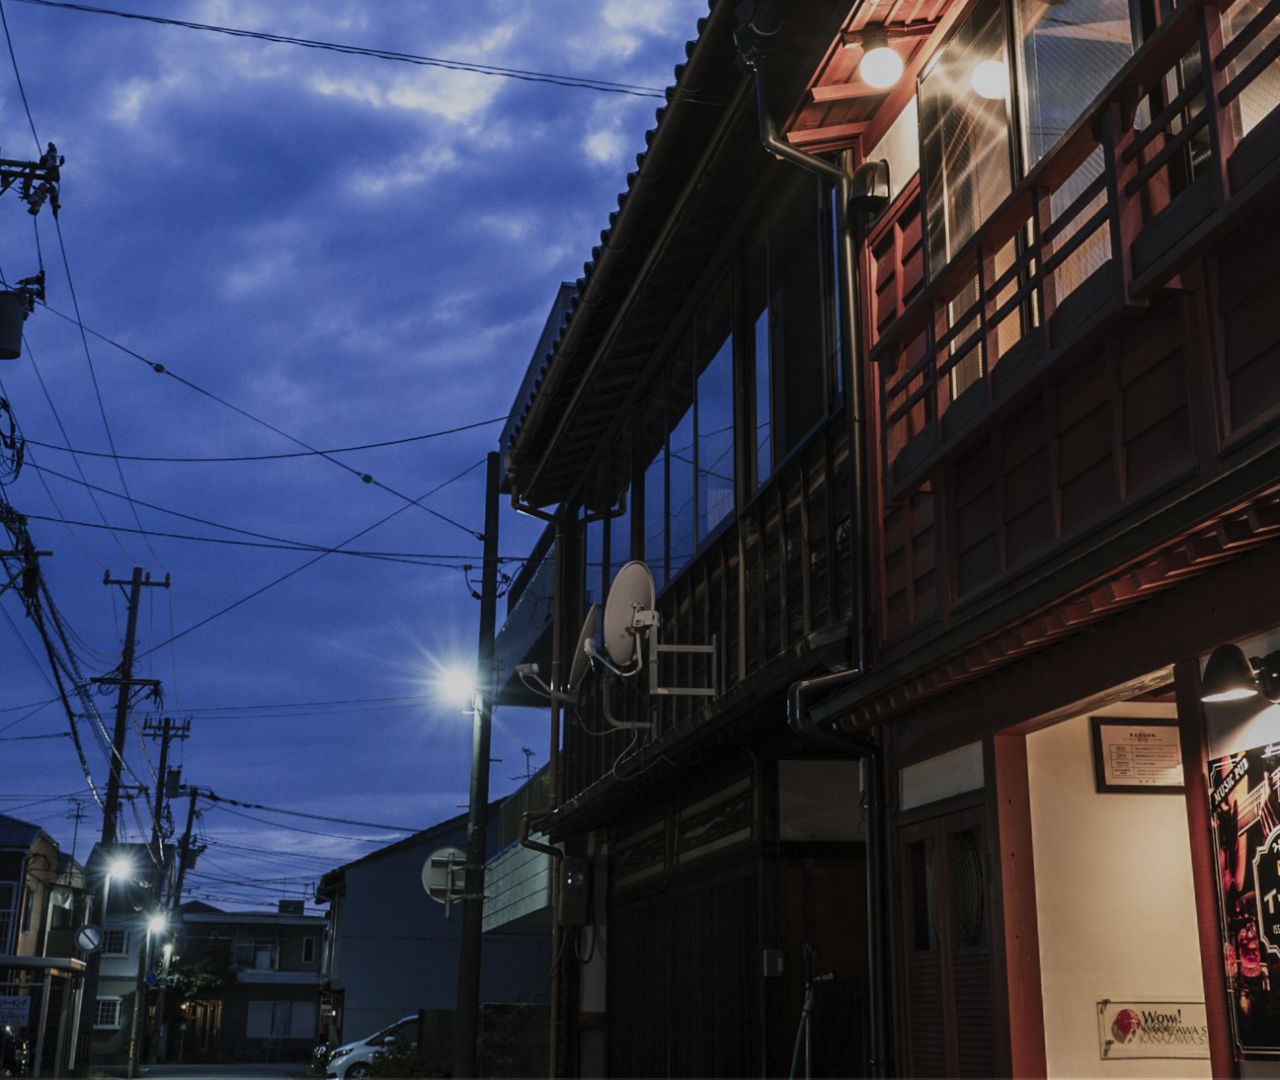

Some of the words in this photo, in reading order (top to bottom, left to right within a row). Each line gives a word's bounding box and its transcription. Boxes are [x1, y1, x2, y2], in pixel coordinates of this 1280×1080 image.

[1213, 773, 1235, 805] MUSIC
[1234, 758, 1249, 780] PUB
[1141, 1008, 1182, 1025] Wow!
